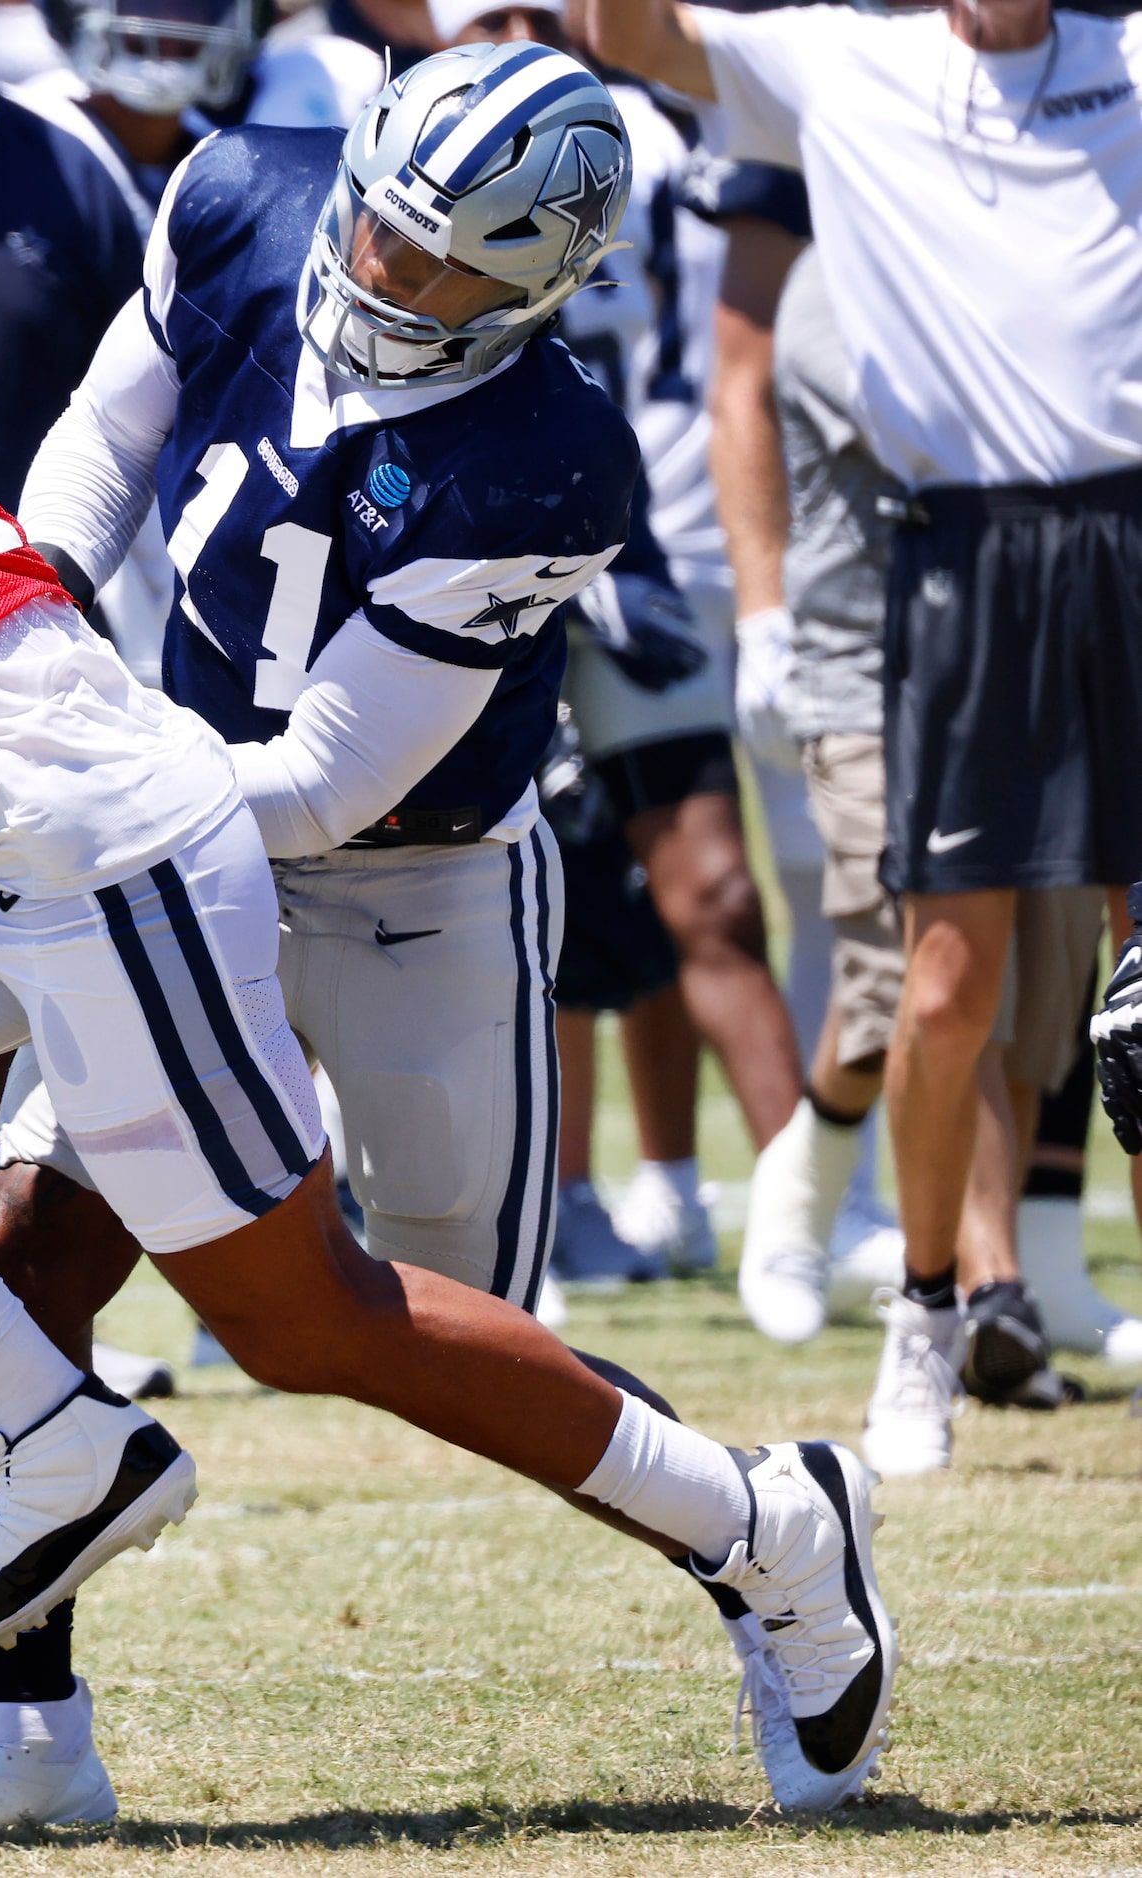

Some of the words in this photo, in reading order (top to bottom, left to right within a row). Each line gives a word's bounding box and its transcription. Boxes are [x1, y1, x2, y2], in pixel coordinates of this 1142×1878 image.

[384, 188, 440, 234] COWBOYS
[256, 436, 300, 498] COWBOYS
[346, 489, 390, 533] AT&T
[167, 441, 332, 712] 11
